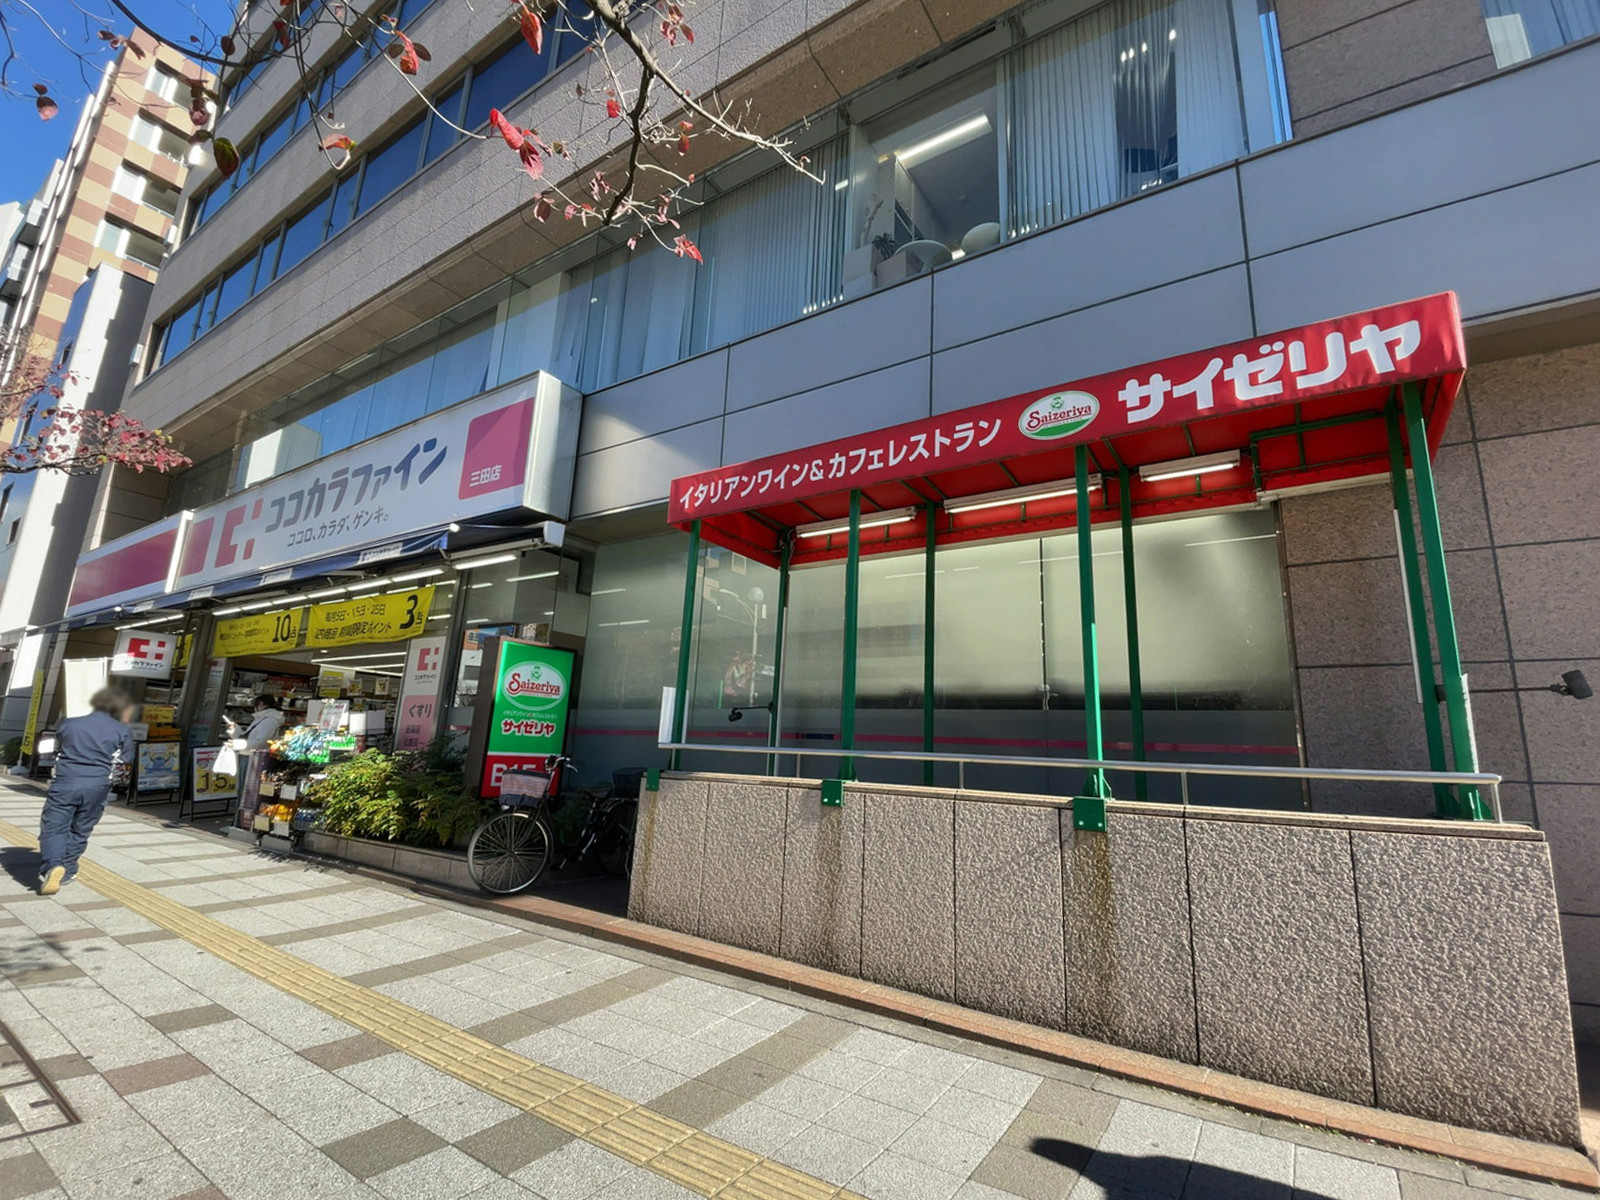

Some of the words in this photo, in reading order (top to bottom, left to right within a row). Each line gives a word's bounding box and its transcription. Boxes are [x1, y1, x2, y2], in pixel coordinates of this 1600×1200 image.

[1117, 319, 1421, 424] サイゼリヤ
[1025, 404, 1092, 431] Saizeriya
[468, 464, 502, 488] 三田店
[680, 418, 1002, 510] イタリアンワイン&カフェレストラン
[264, 437, 449, 534] ココカラファイン
[506, 672, 561, 696] Saizeriya
[408, 703, 432, 719] くすり
[501, 718, 557, 738] サイゼリヤ
